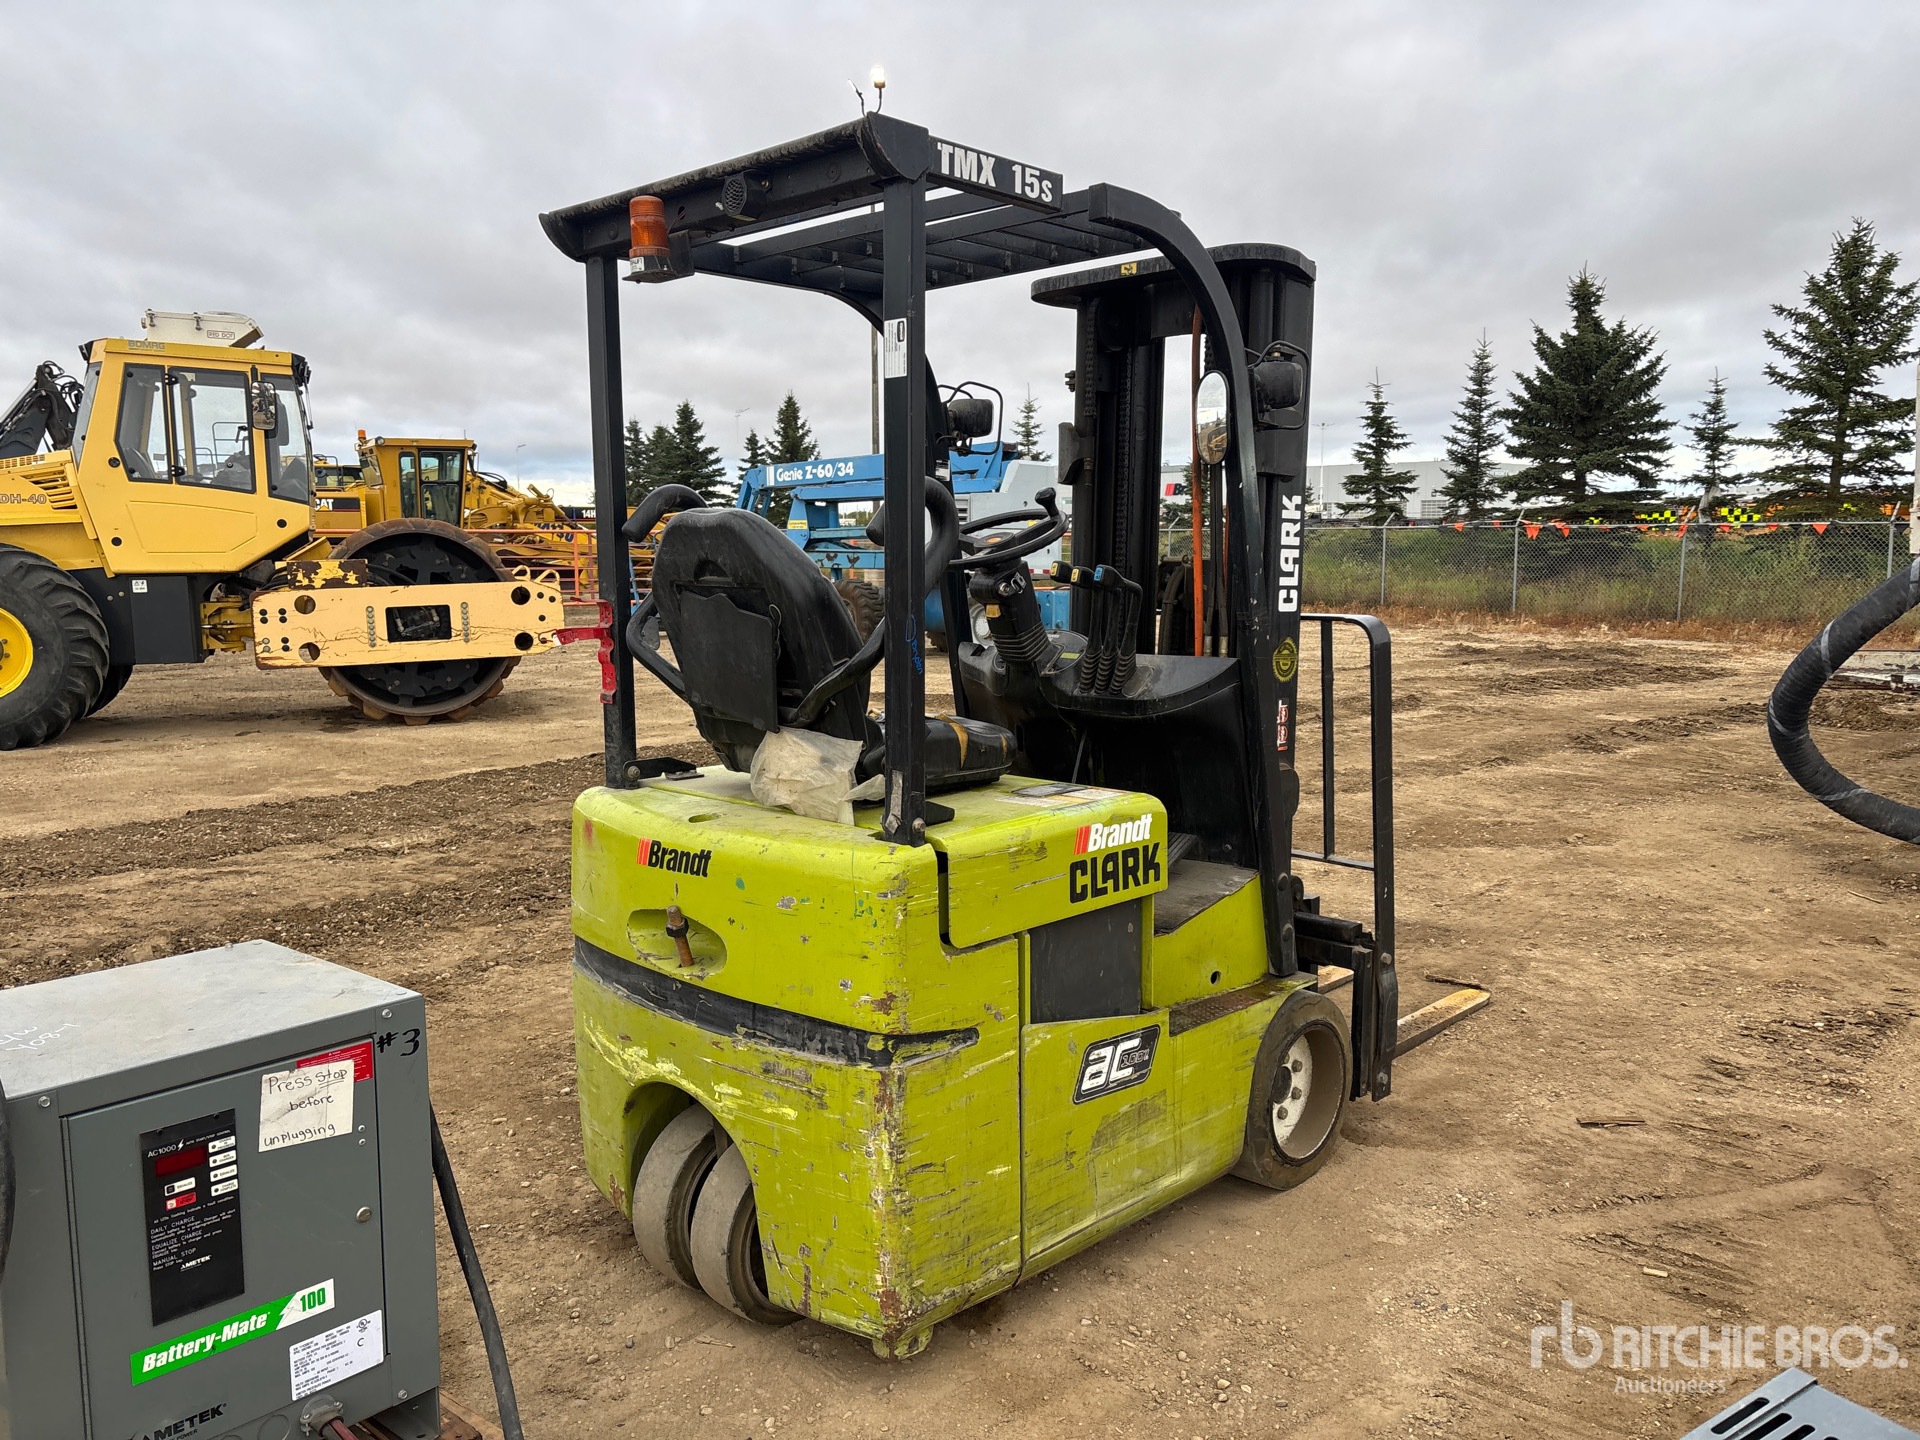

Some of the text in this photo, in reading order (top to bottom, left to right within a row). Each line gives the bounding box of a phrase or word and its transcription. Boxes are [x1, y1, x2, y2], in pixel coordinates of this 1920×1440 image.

[937, 142, 996, 187] TMX
[128, 340, 165, 349] BOMAG
[776, 462, 854, 482] Genie Z-60/34
[315, 499, 334, 511] CAT
[1278, 495, 1302, 612] CLARK
[1088, 813, 1153, 852] Brandt
[648, 840, 712, 878] Brandt
[1069, 842, 1161, 904] CLARK
[268, 1075, 312, 1095] Press
[289, 1095, 334, 1111] before
[264, 1123, 336, 1147] unplugging
[148, 1144, 176, 1158] AC1000
[150, 1216, 195, 1235] DAILY CHARGE
[152, 1230, 202, 1250] EQUALIZE CHARGE
[153, 1248, 196, 1266] MANUAL STOP
[180, 1255, 211, 1269] AMETEK
[142, 1313, 267, 1373] Battery-Mate
[300, 1287, 326, 1312] 100
